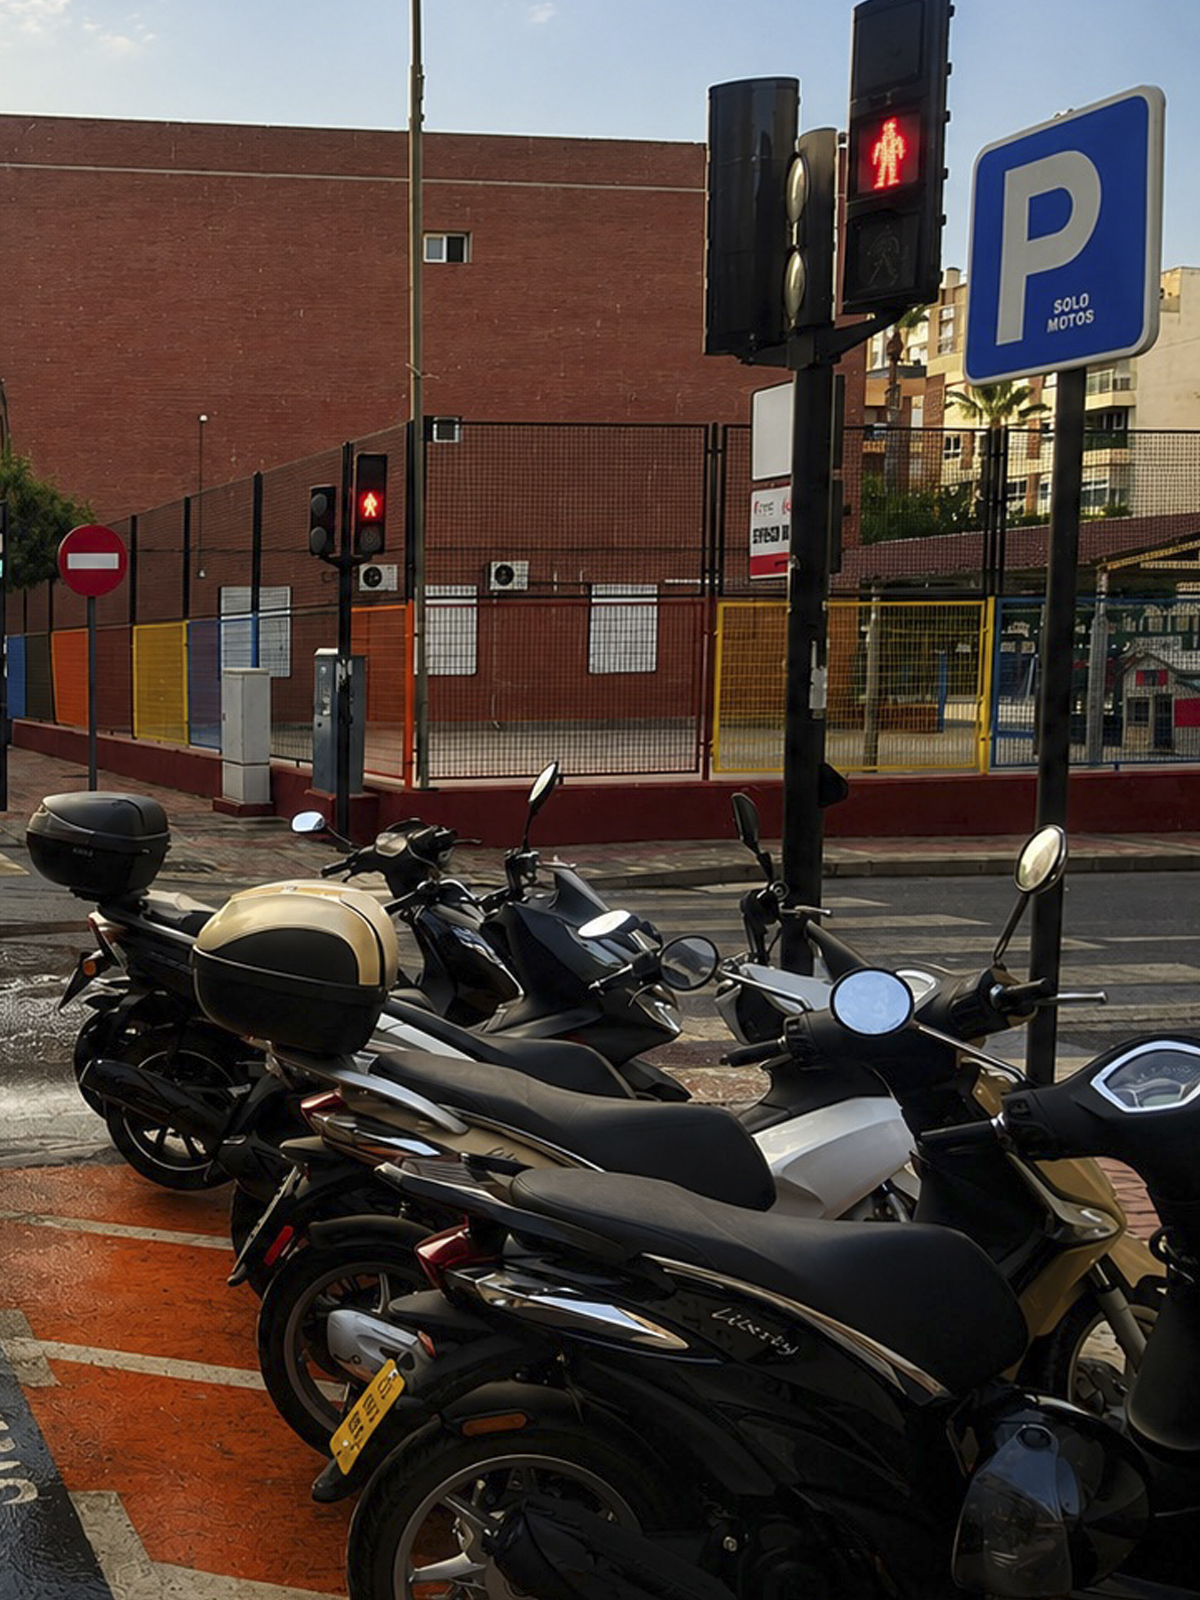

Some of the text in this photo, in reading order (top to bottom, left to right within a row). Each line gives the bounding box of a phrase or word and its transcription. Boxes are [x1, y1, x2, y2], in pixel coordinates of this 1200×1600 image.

[996, 149, 1102, 347] P
[1053, 293, 1089, 313] SOLO
[1046, 309, 1095, 333] MOTOS
